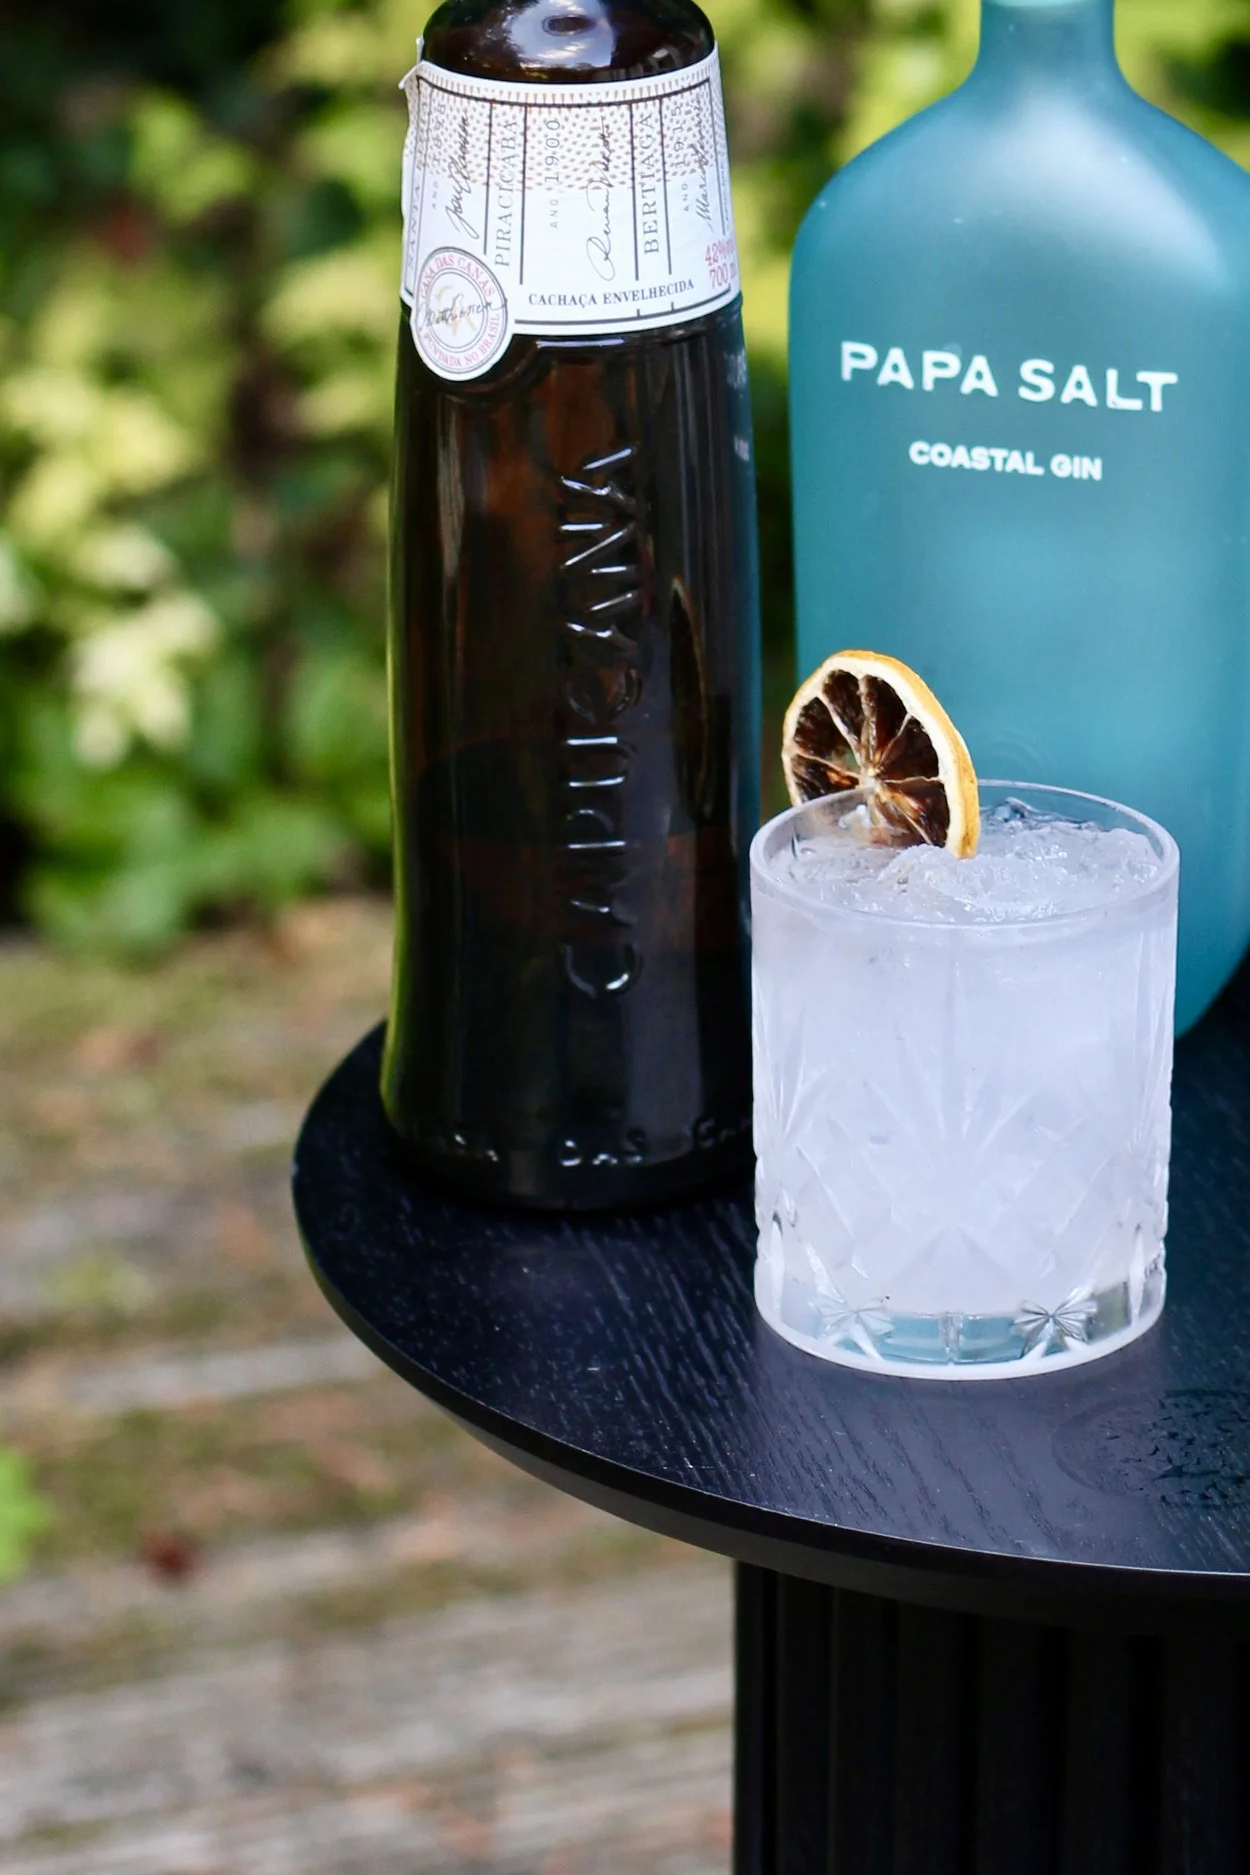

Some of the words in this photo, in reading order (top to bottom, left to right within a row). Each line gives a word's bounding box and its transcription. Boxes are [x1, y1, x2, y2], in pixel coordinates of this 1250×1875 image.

[544, 119, 561, 184] 1900
[671, 105, 685, 167] 1915
[495, 120, 518, 267] PIRACICABA
[549, 198, 560, 229] ANO
[639, 112, 661, 255] BERTIAGA
[682, 182, 690, 213] ANO
[434, 253, 456, 267] DAS
[457, 257, 496, 299] CANAS
[528, 292, 597, 309] CACHAÇA
[603, 278, 695, 305] ENVELHECIDA
[841, 340, 998, 398] PAPA
[1018, 358, 1179, 413] SALT
[909, 440, 1045, 476] COASTAL
[1050, 454, 1103, 481] GIN
[560, 445, 641, 1000] CAPUCANA
